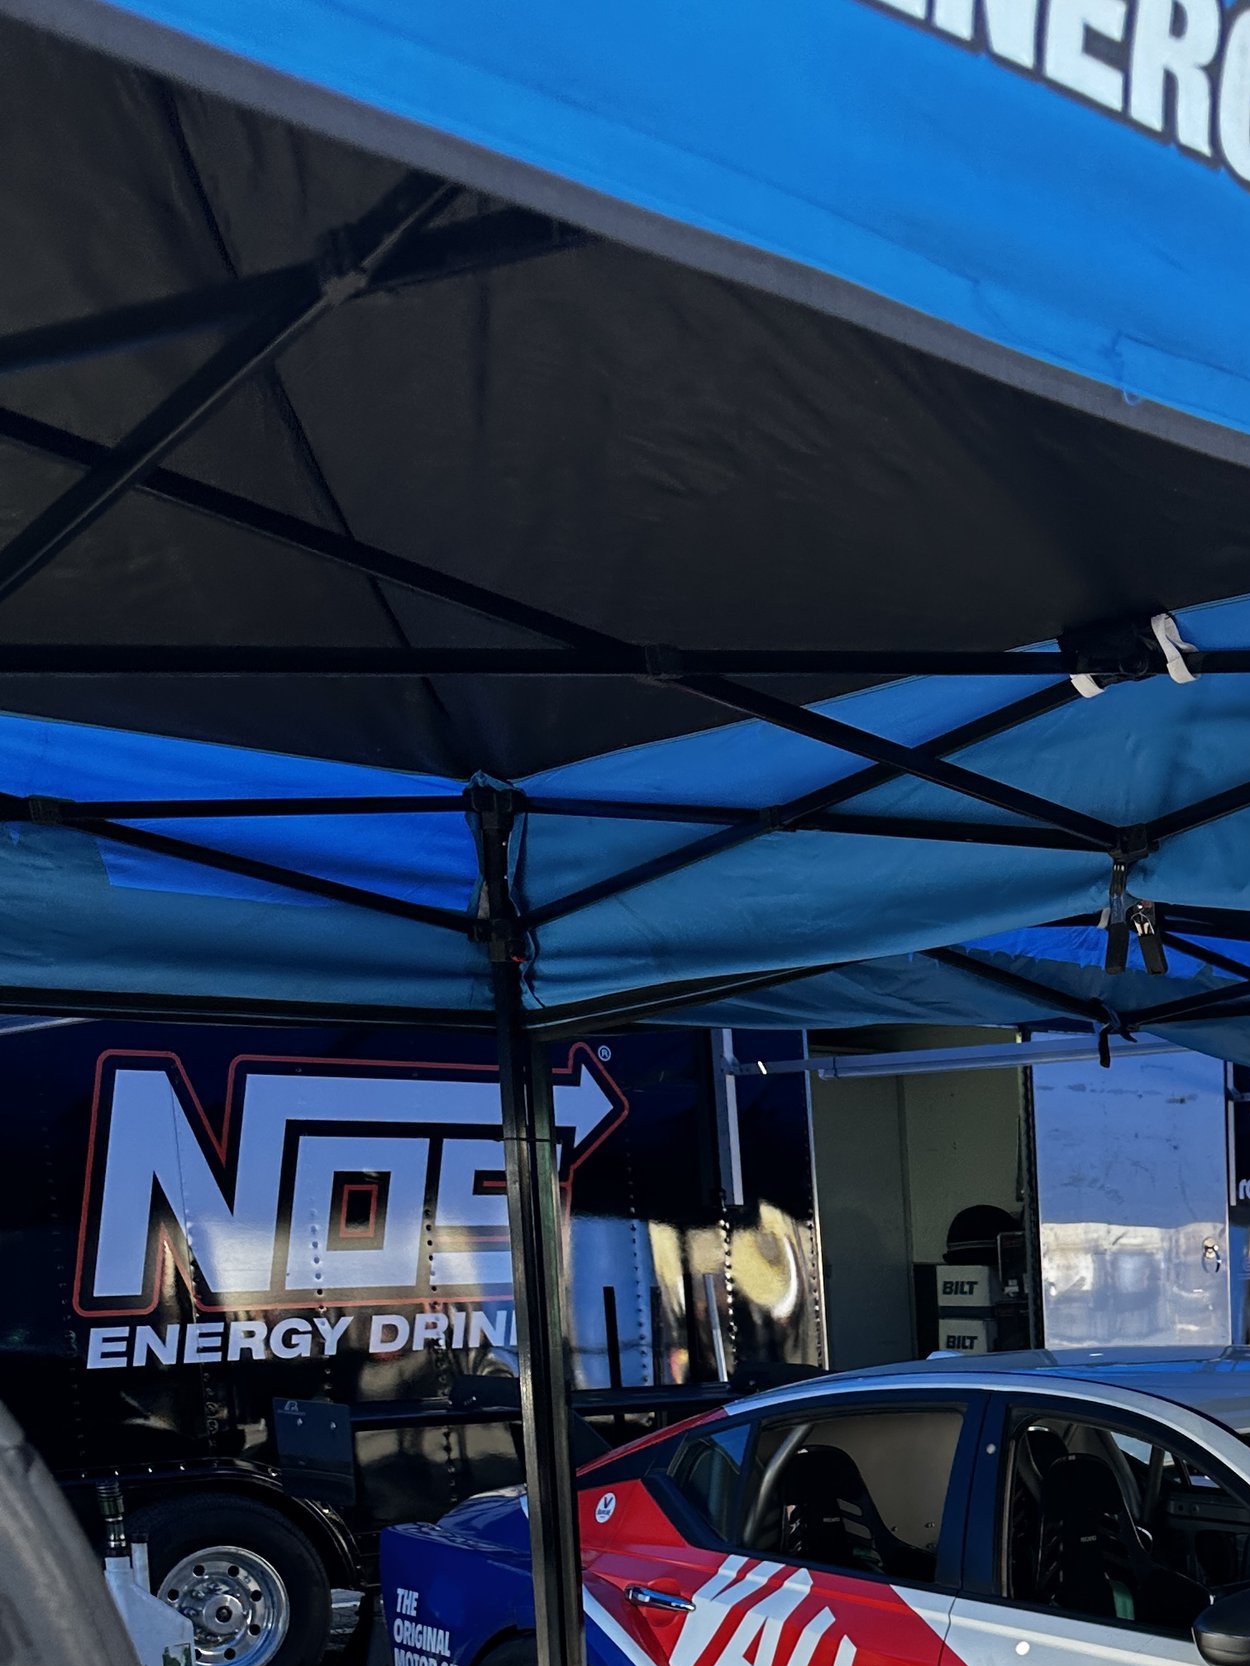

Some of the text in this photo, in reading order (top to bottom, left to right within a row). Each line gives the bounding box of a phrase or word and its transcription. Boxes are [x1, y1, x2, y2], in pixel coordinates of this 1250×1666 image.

[942, 1281, 979, 1295] BILT
[86, 1310, 518, 1370] ENERGY DRIN
[946, 1335, 978, 1349] BILT
[396, 1588, 419, 1616] THE
[393, 1618, 451, 1657] ORIGINAL
